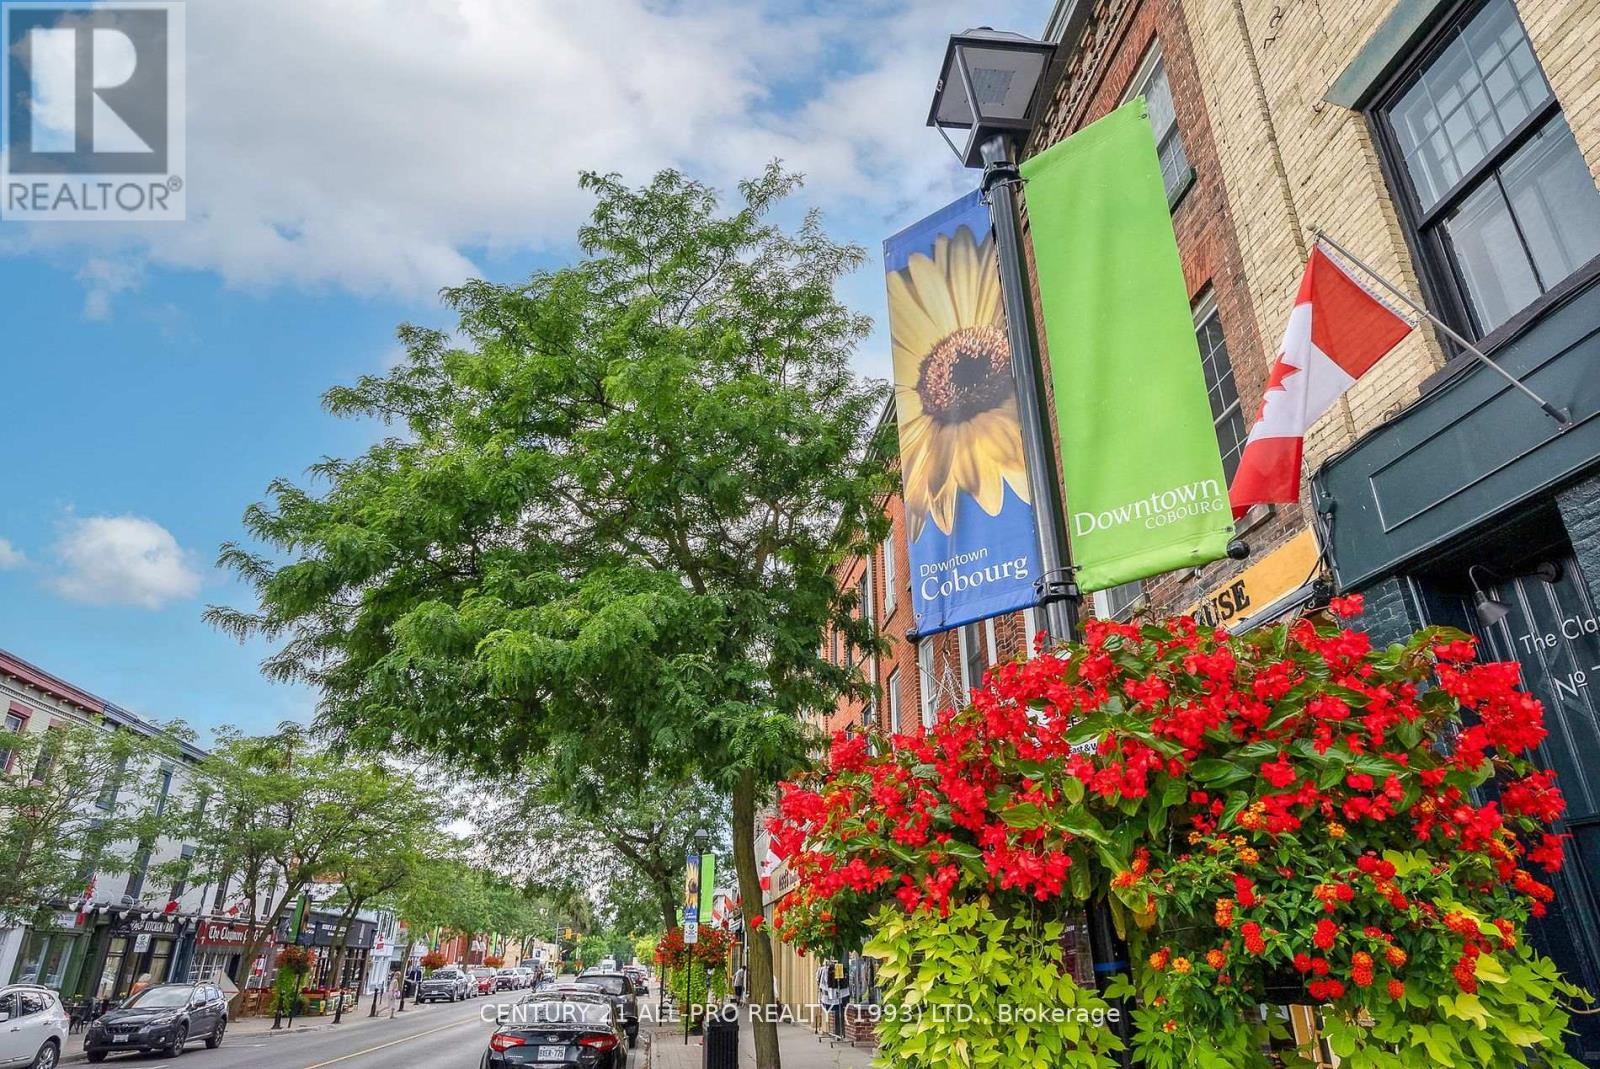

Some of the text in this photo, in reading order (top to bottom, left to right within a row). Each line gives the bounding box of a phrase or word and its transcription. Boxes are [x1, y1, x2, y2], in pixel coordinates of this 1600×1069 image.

[1074, 478, 1222, 537] Downtown
[1144, 499, 1224, 530] COBOURG
[919, 547, 988, 577] Downtown
[921, 556, 1029, 601] Cobourg
[1190, 579, 1251, 628] USE
[1519, 614, 1600, 655] The Cla
[208, 925, 220, 942] The
